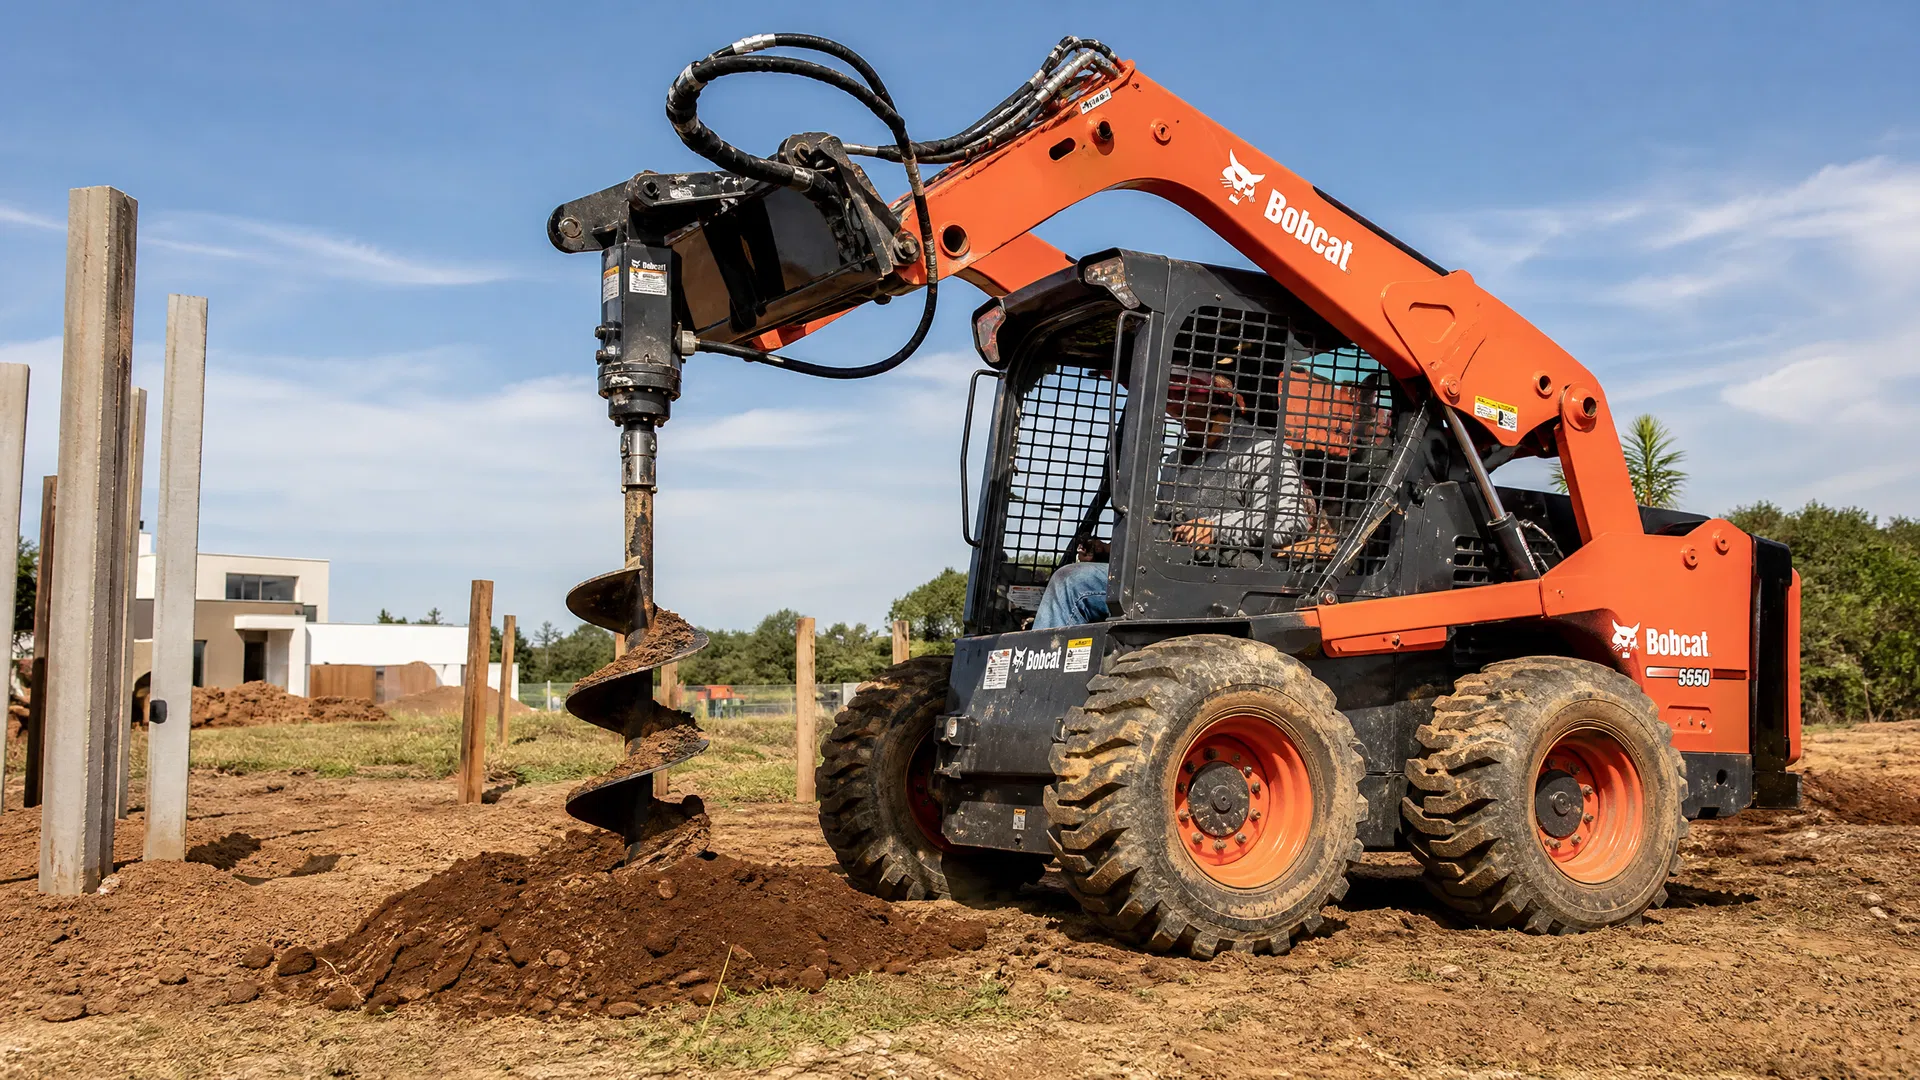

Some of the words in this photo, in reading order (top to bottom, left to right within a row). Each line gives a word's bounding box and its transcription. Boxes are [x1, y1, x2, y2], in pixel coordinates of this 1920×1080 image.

[1264, 188, 1353, 272] Bobcat
[1646, 628, 1709, 657] Bobcat
[1025, 646, 1062, 671] Bobcat
